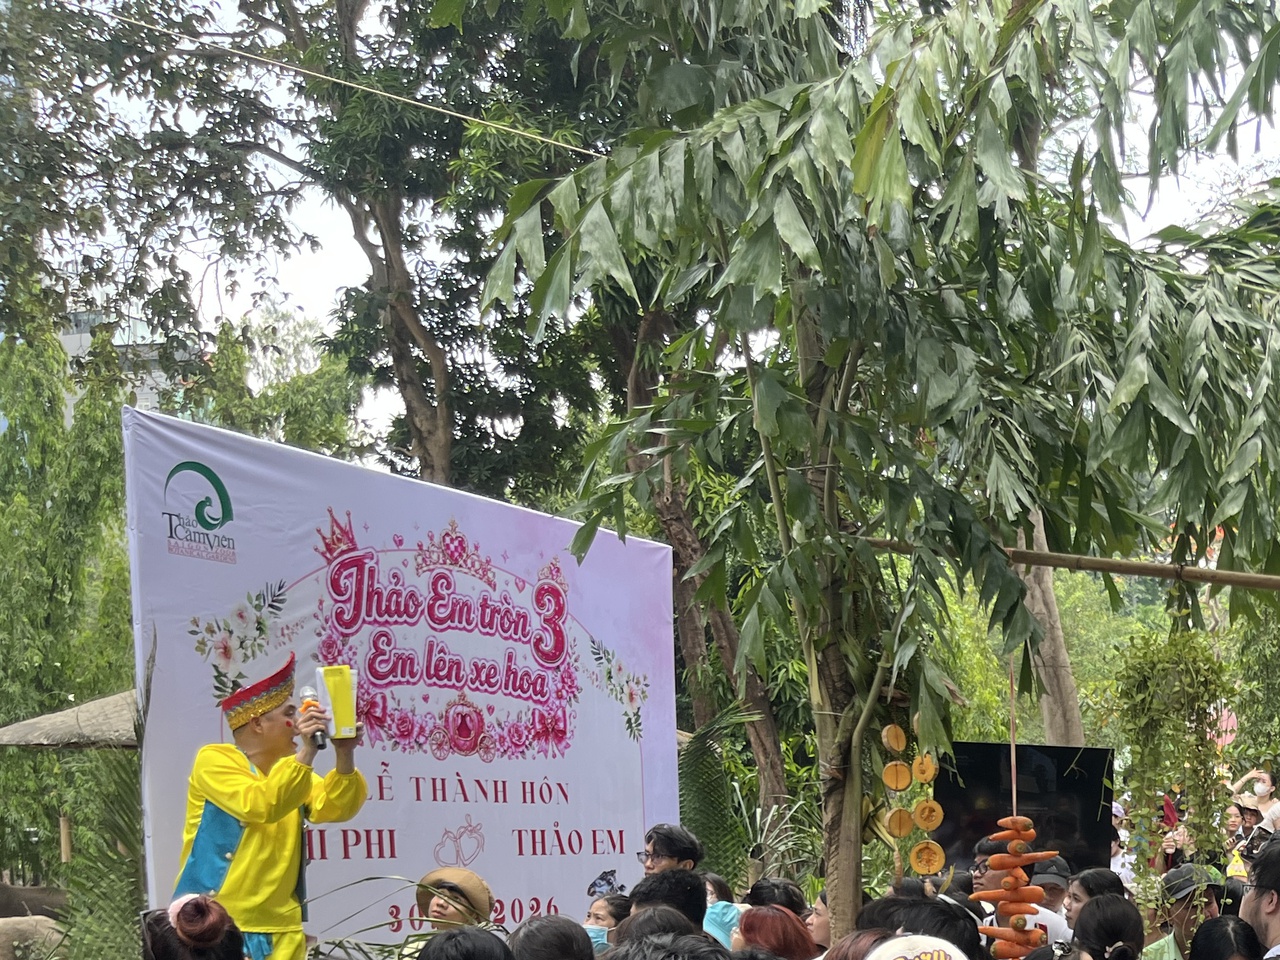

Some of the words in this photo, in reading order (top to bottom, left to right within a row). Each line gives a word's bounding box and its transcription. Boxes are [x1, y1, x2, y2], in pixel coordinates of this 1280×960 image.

[329, 550, 424, 631] Thảo
[427, 571, 474, 626] Em
[479, 593, 530, 639] tròn
[532, 582, 566, 662] 3
[367, 630, 418, 681] Em
[425, 640, 465, 683] lên
[469, 660, 499, 686] xe
[504, 651, 549, 697] hoa
[367, 761, 395, 801] Ễ
[409, 771, 509, 804] THÀNH
[521, 776, 570, 805] HÔN
[341, 829, 398, 860] PHI
[512, 821, 583, 856] THẢO
[591, 829, 626, 855] EM
